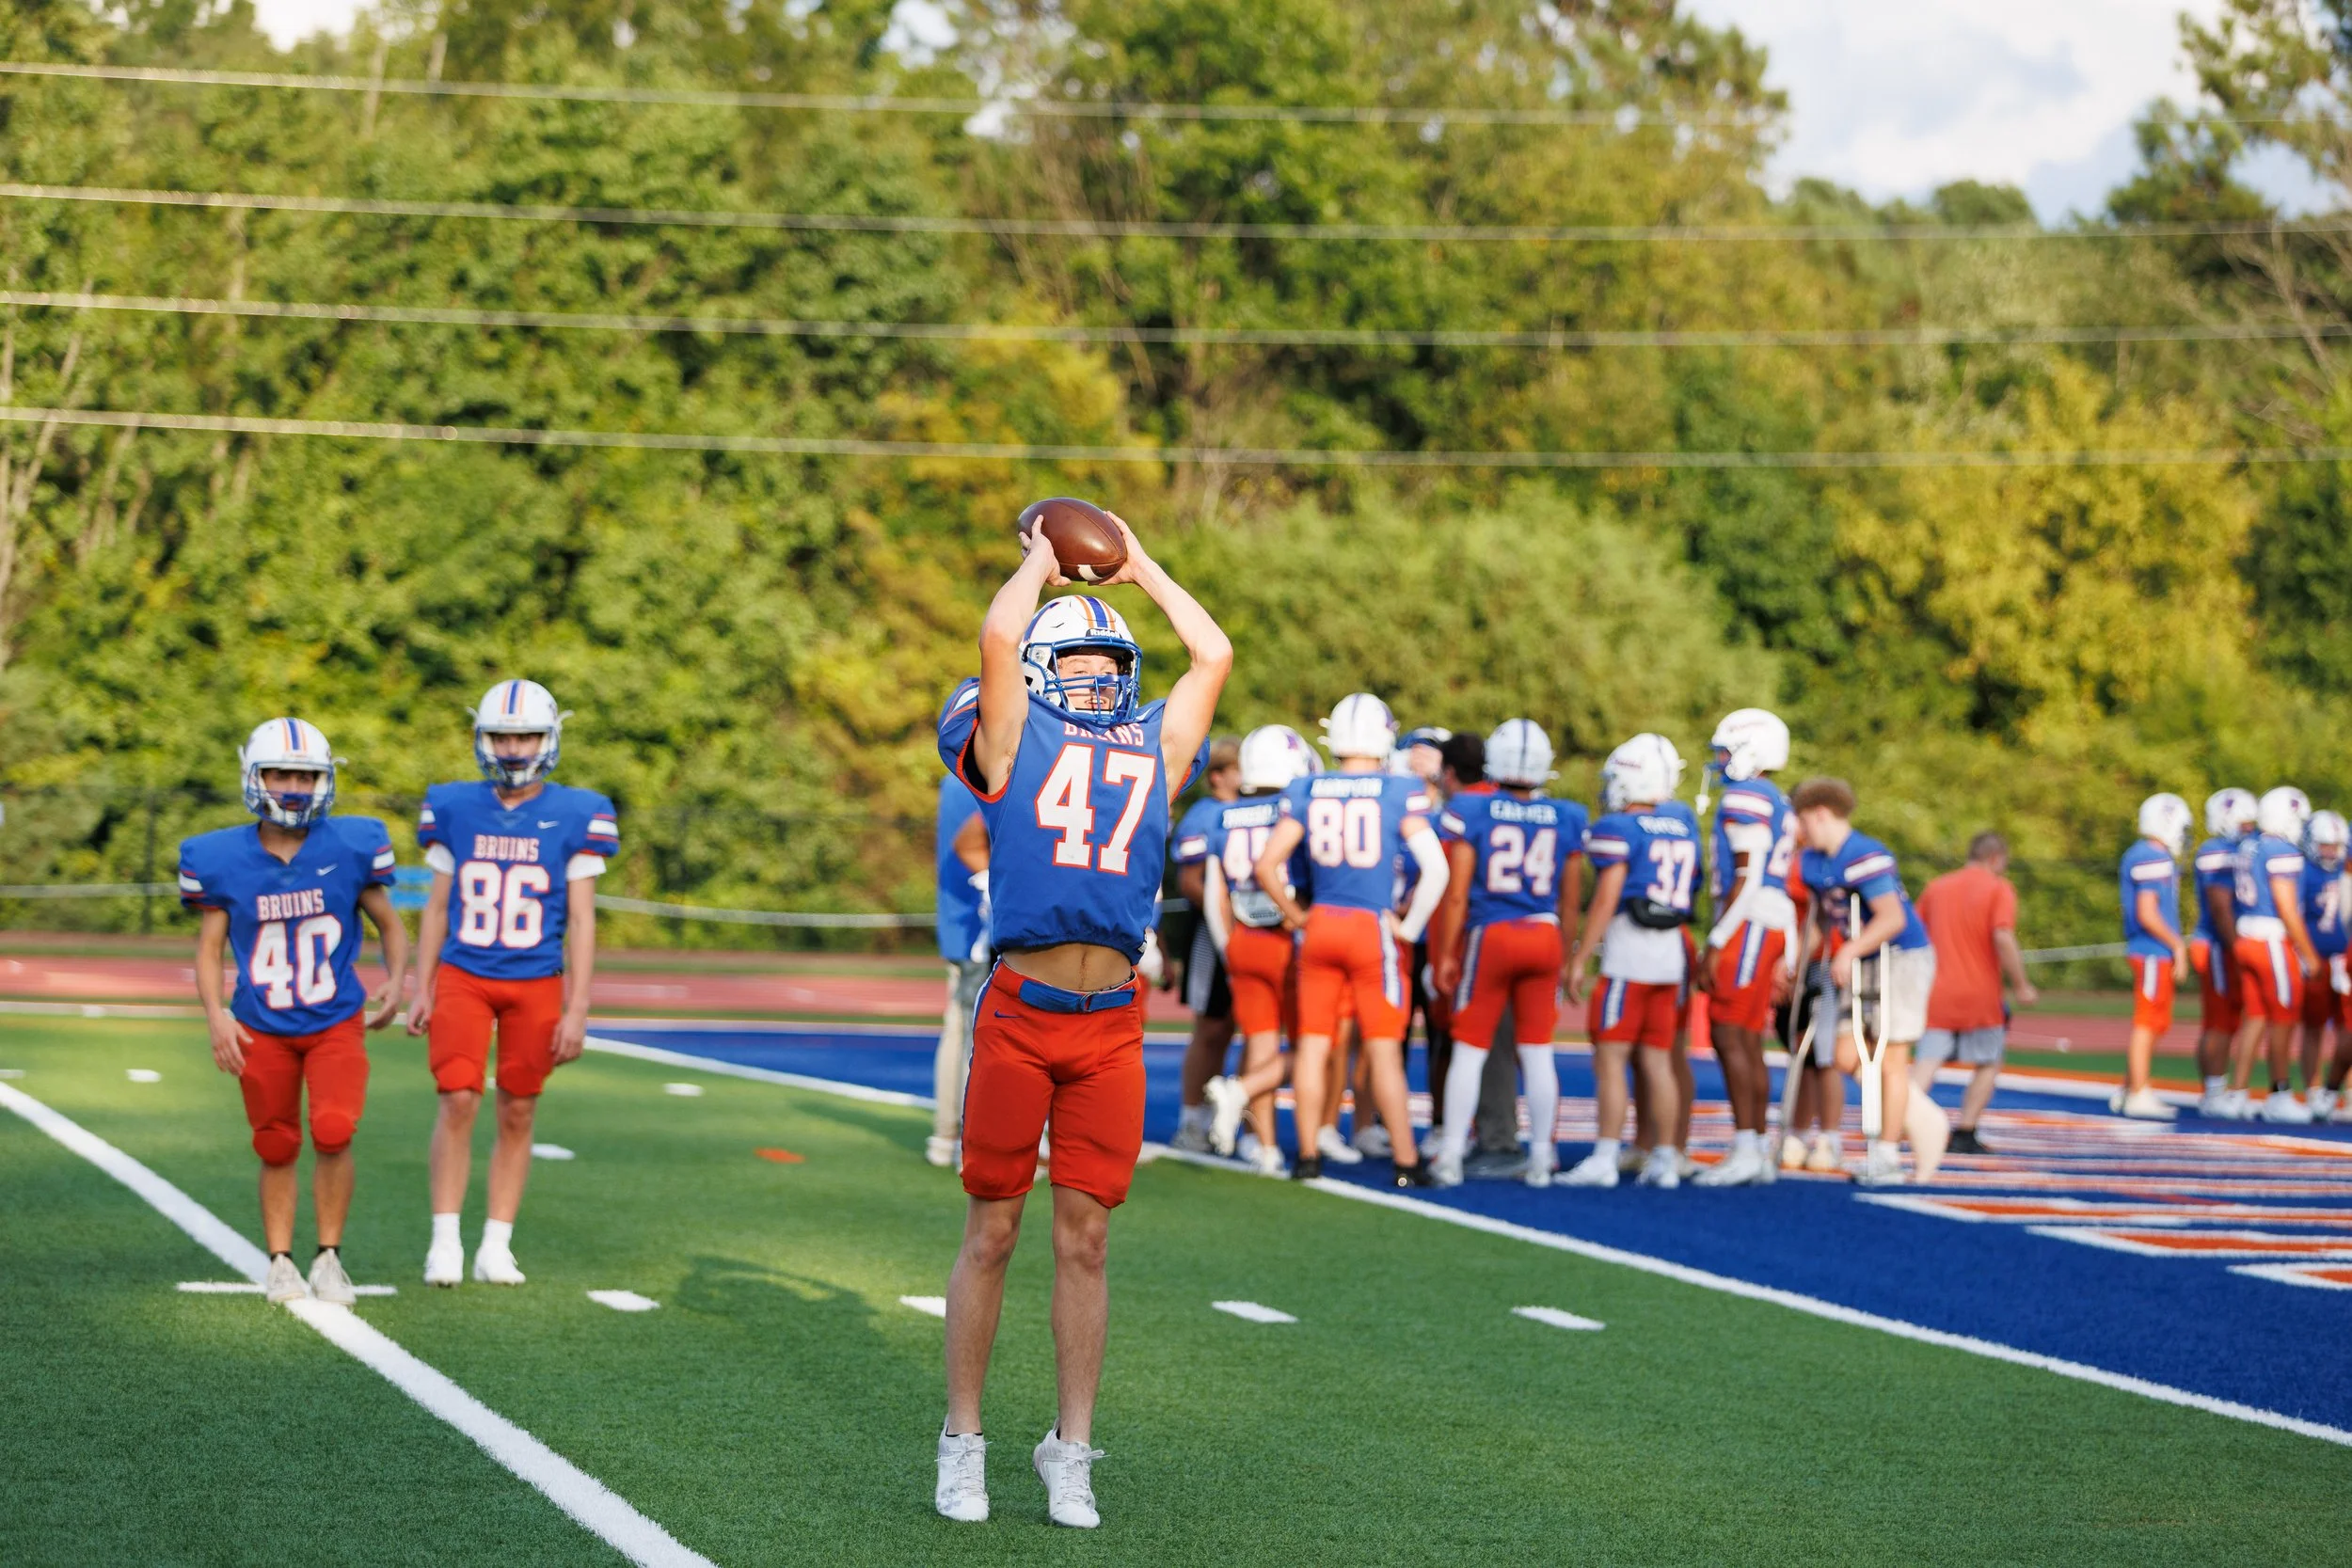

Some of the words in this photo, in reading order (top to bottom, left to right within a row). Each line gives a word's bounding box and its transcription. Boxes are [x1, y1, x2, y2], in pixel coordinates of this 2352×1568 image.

[1035, 741, 1156, 874] 47
[1308, 798, 1382, 868] 80
[473, 833, 540, 863] BRUINS
[1486, 825, 1557, 896] 24
[1647, 839, 1696, 909] 37
[256, 888, 326, 921] BRUINS
[458, 860, 550, 949] 86
[249, 913, 342, 1010] 40
